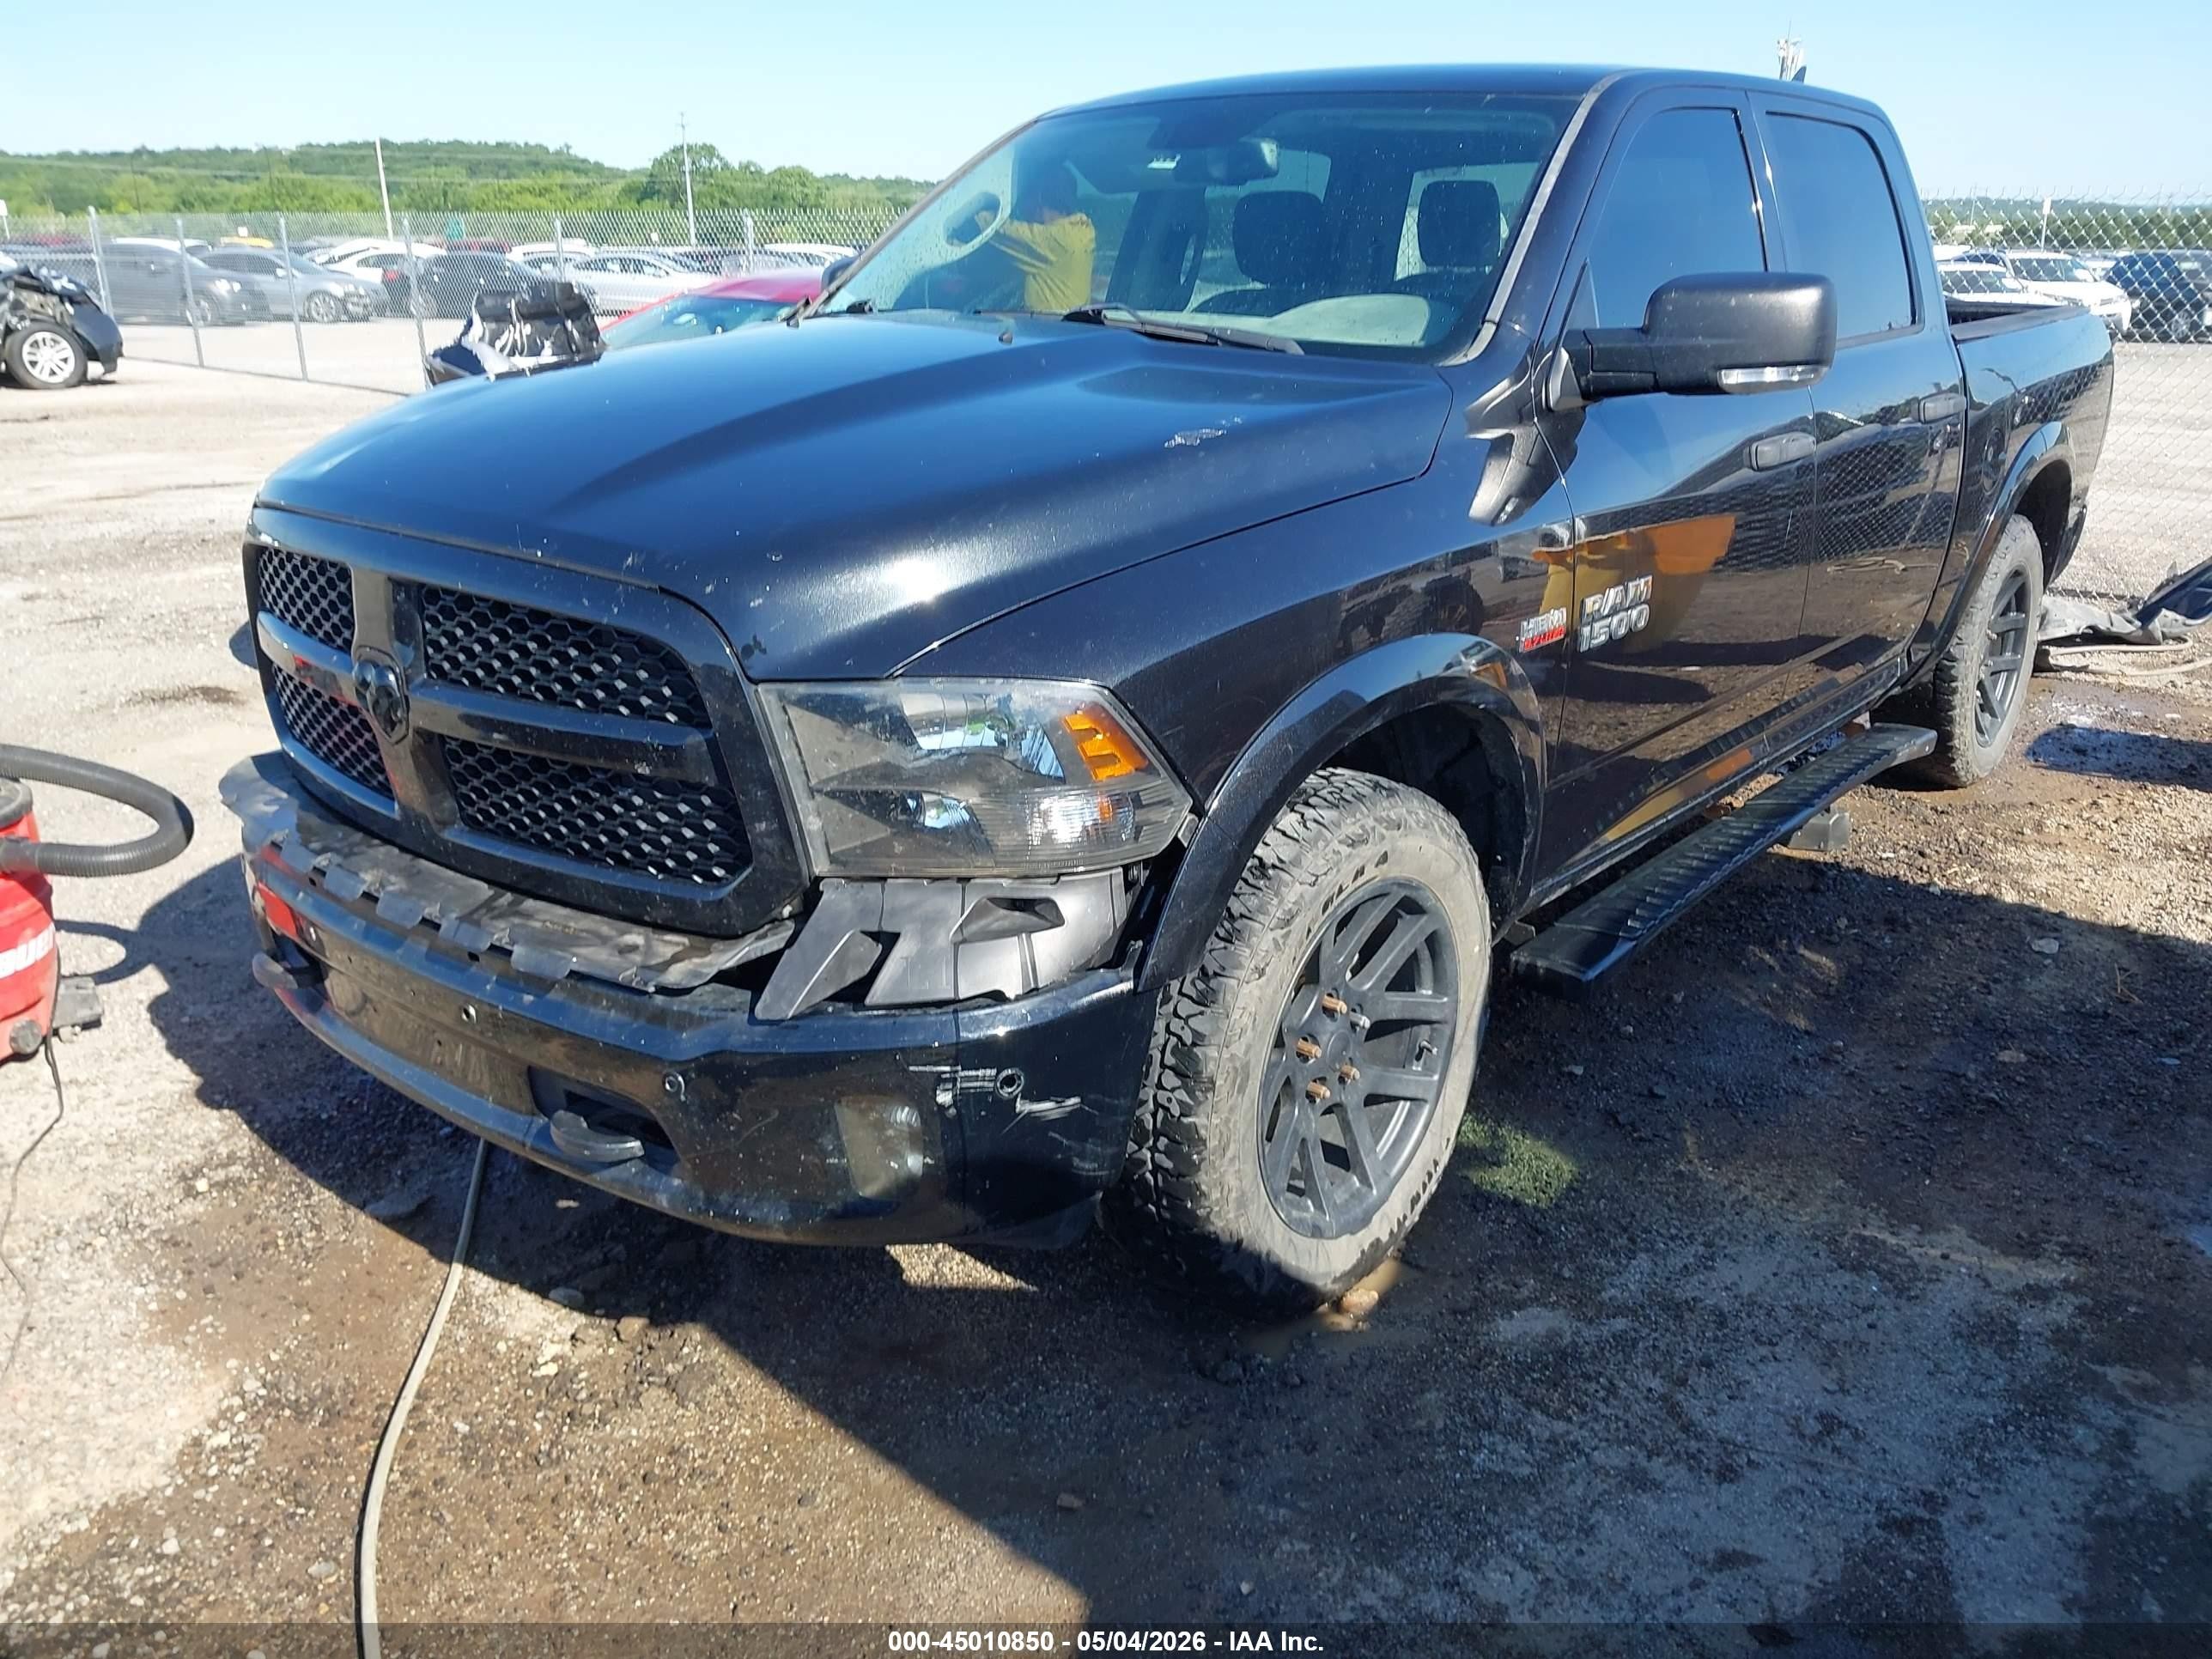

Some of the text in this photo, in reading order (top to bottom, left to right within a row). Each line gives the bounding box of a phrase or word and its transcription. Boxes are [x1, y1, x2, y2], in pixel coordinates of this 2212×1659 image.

[1521, 607, 1567, 639] HEMI
[1583, 575, 1653, 623] RAM
[1580, 604, 1650, 653] 1500
